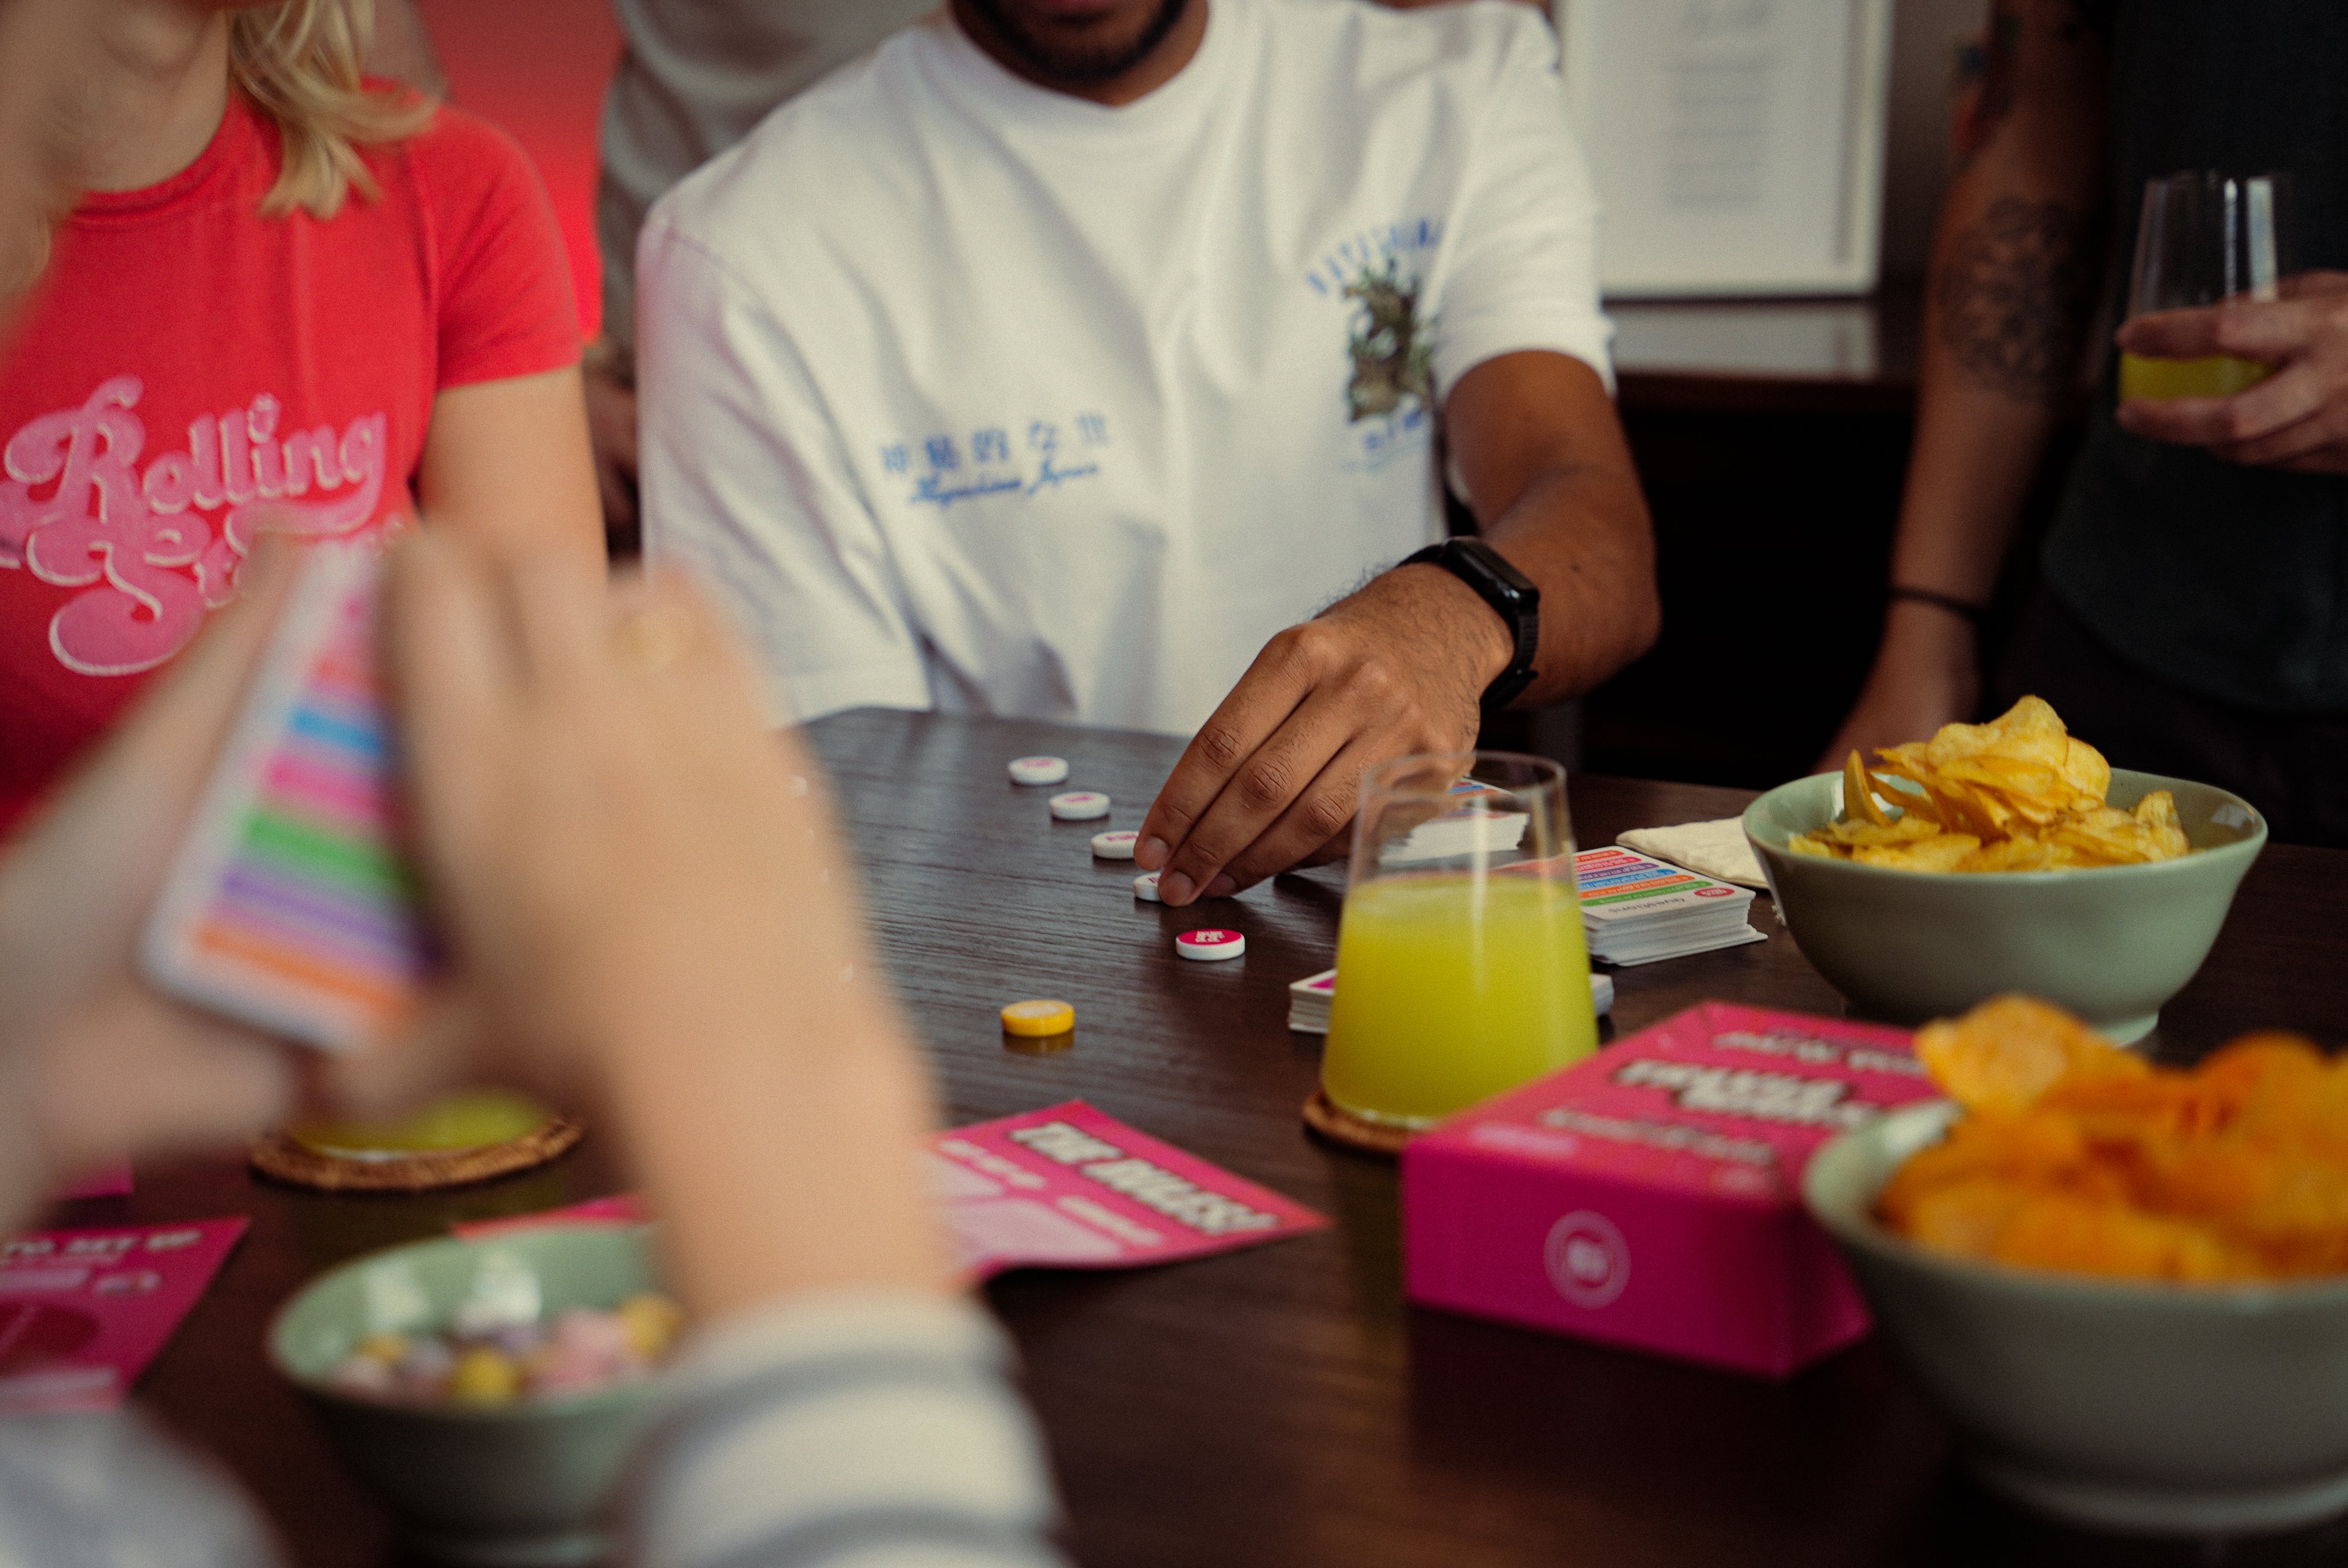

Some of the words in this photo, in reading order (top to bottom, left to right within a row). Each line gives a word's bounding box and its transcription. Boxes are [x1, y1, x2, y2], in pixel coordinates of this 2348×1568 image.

[4, 372, 388, 554] Rolling
[1009, 1121, 1124, 1164] THE
[1080, 1158, 1280, 1236] RULES!
